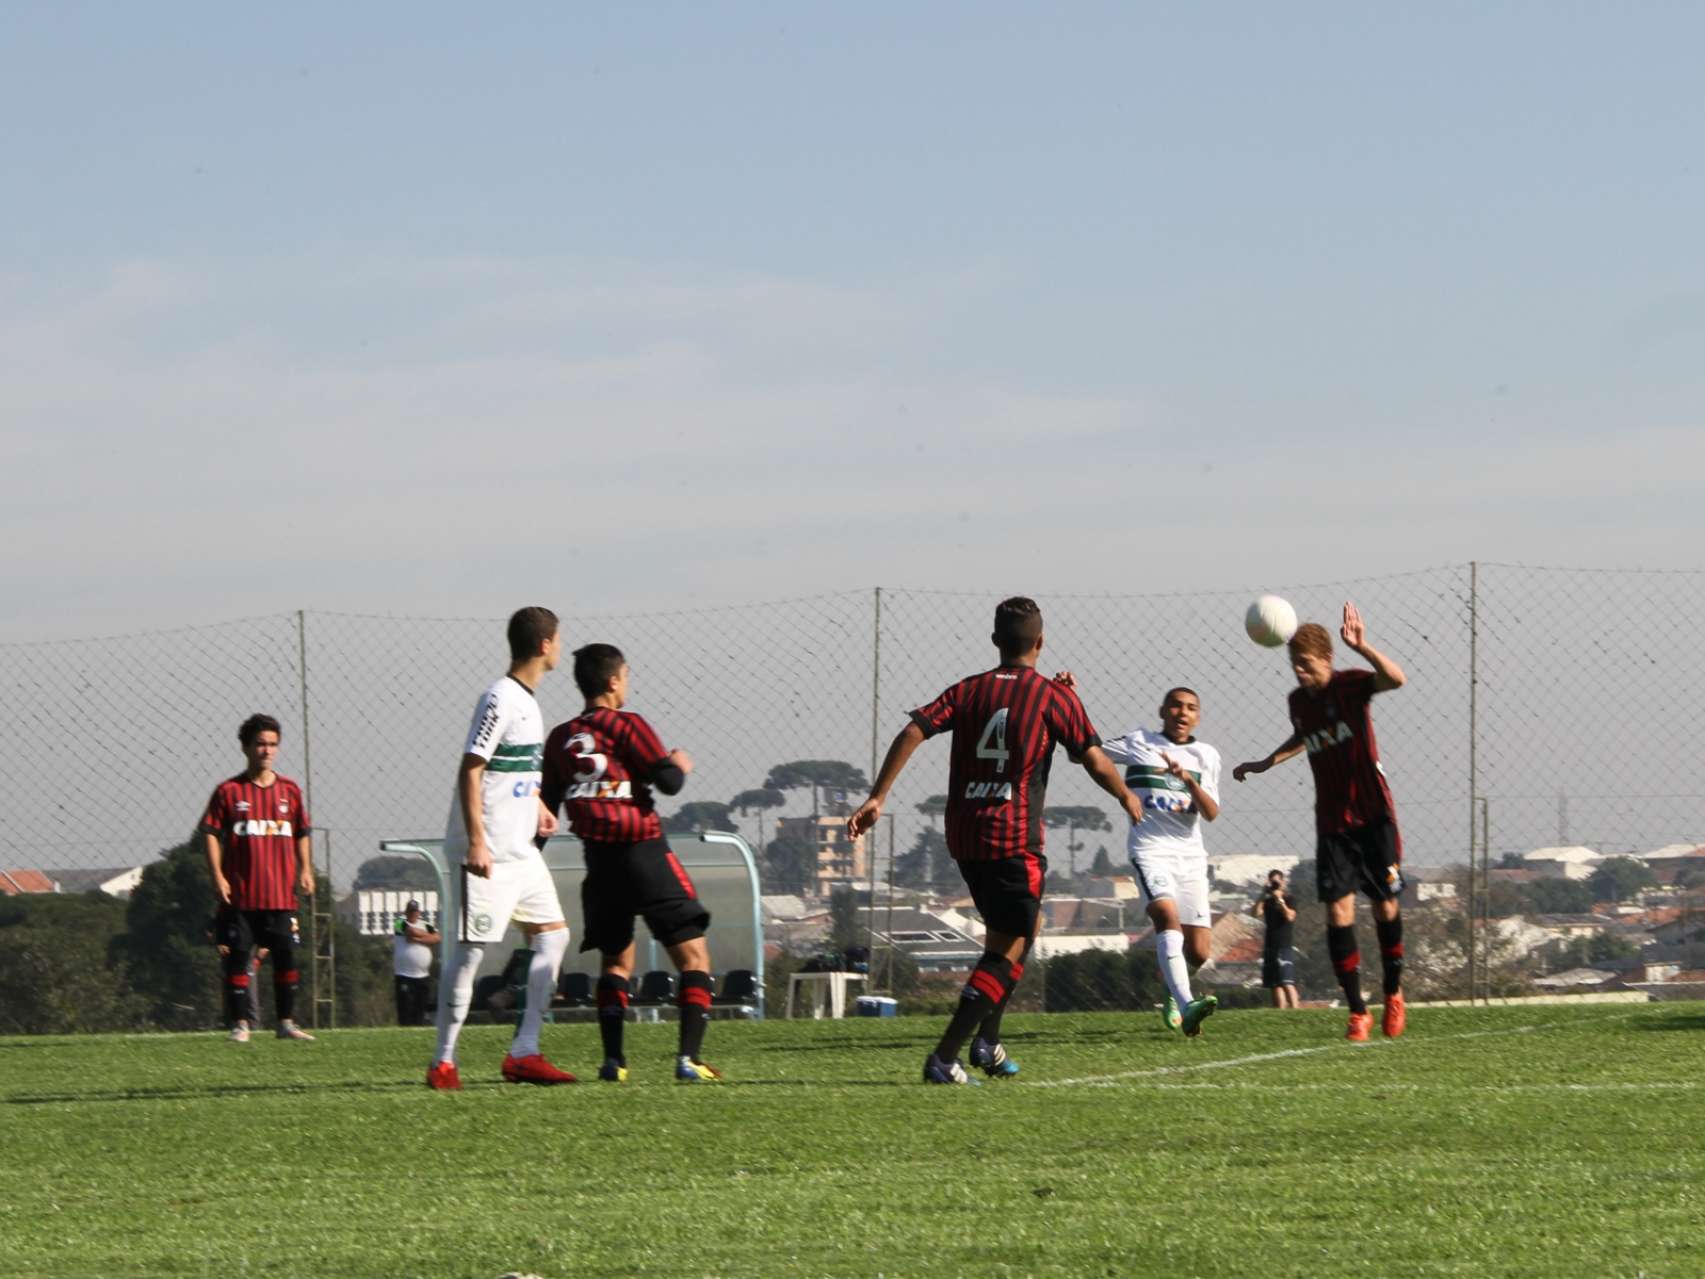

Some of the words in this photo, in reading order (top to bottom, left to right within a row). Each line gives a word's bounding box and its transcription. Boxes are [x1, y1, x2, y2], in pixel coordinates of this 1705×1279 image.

[564, 732, 608, 782] 3
[976, 707, 1009, 773] 4
[566, 781, 633, 799] CAIXA
[233, 819, 292, 837] CAIXA
